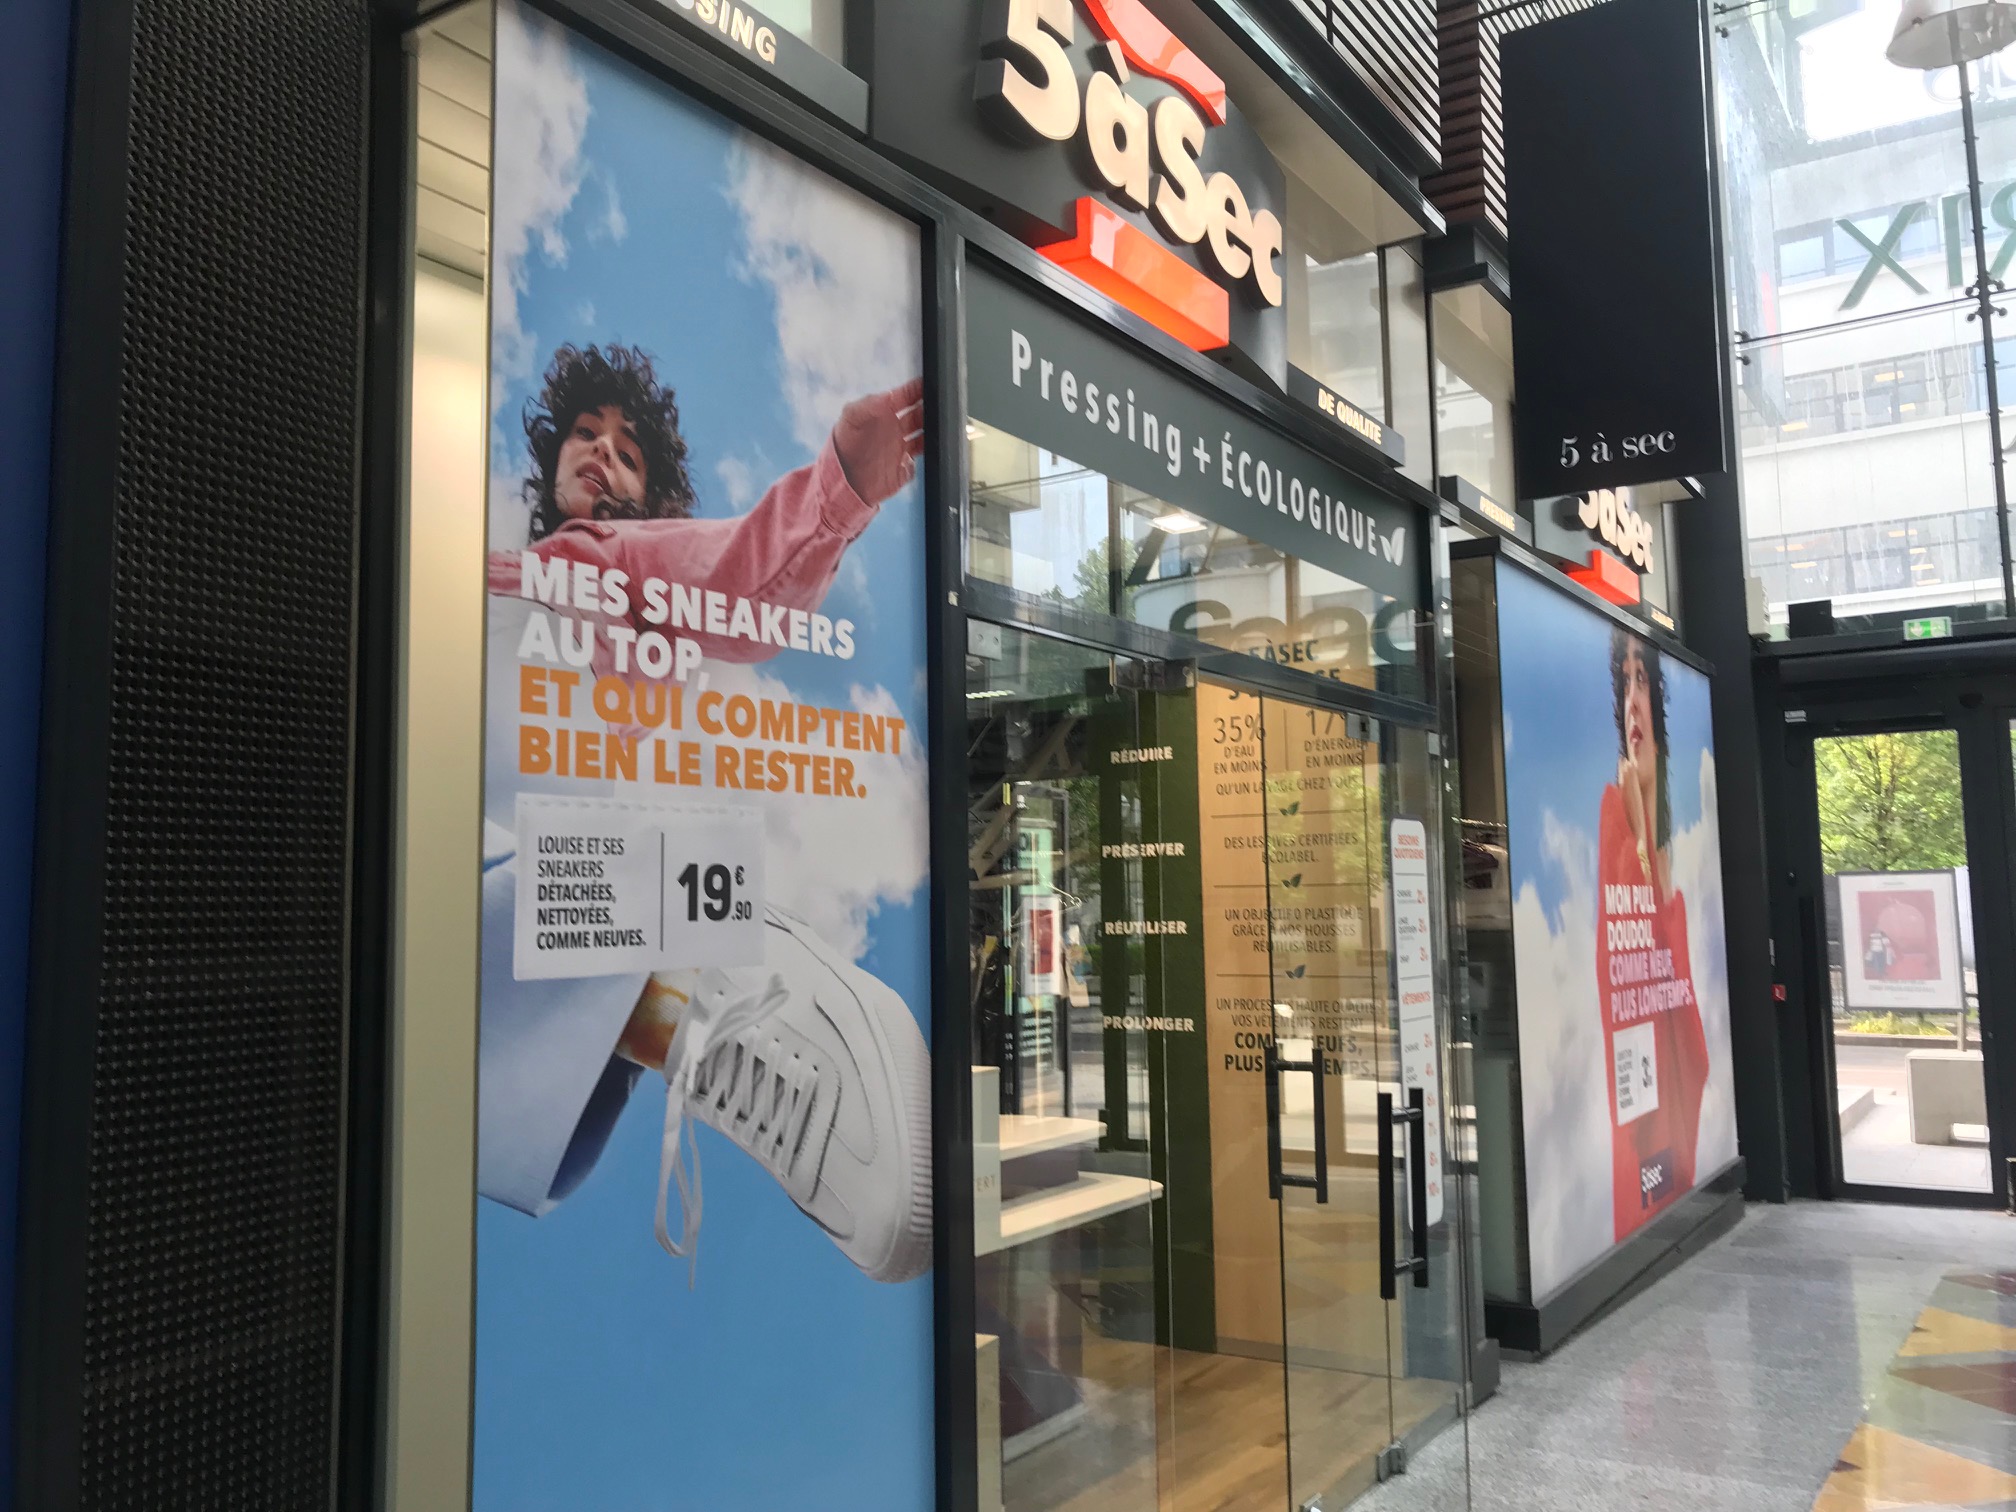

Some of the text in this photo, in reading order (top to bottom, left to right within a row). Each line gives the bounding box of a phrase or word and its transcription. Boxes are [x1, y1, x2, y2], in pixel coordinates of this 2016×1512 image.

[676, 0, 777, 65] SING
[1318, 387, 1335, 416] DE
[1011, 329, 1181, 477] Pressing
[1221, 431, 1377, 557] ÉCOLOGIQUE
[1560, 430, 1676, 468] 5 à sec
[520, 552, 856, 660] MES SNEAKERS
[517, 613, 709, 690] AU TOP,
[519, 665, 906, 755] ET QUI COMPTENT
[1213, 714, 1266, 744] 35%
[1306, 709, 1345, 736] 17
[519, 725, 867, 799] BIEN LE RESTER.
[1224, 745, 1255, 759] D'EAU
[1306, 752, 1364, 768] EN MOINS
[1214, 762, 1228, 775] EN
[1297, 777, 1326, 791] CHEZ
[538, 836, 625, 855] LOUISE ET SES
[1102, 842, 1185, 859] PRÉSERVER
[1224, 837, 1244, 849] DES
[537, 860, 604, 878] SNEAKERS
[537, 879, 616, 903] DÉTACHÉES,
[677, 863, 732, 921] 19
[1605, 884, 1657, 915] MON PULL
[537, 903, 614, 926] NETTOYÉES,
[1225, 909, 1240, 921] UN
[1243, 908, 1291, 920] OBJECTIF
[1105, 919, 1188, 936] RÉUTILISER
[1232, 922, 1266, 937] GRÂCE
[1280, 924, 1301, 936] NOS
[1305, 924, 1356, 936] HOUSSES
[536, 929, 646, 950] COMME NEUVES.
[1609, 951, 1649, 987] COMME
[1216, 998, 1231, 1010] UN
[1296, 1000, 1329, 1013] HAUTE
[1610, 988, 1638, 1024] PLUS
[1103, 1015, 1195, 1032] PROLONGER
[1231, 1014, 1252, 1027] VOS
[1224, 1054, 1263, 1072] PLUS
